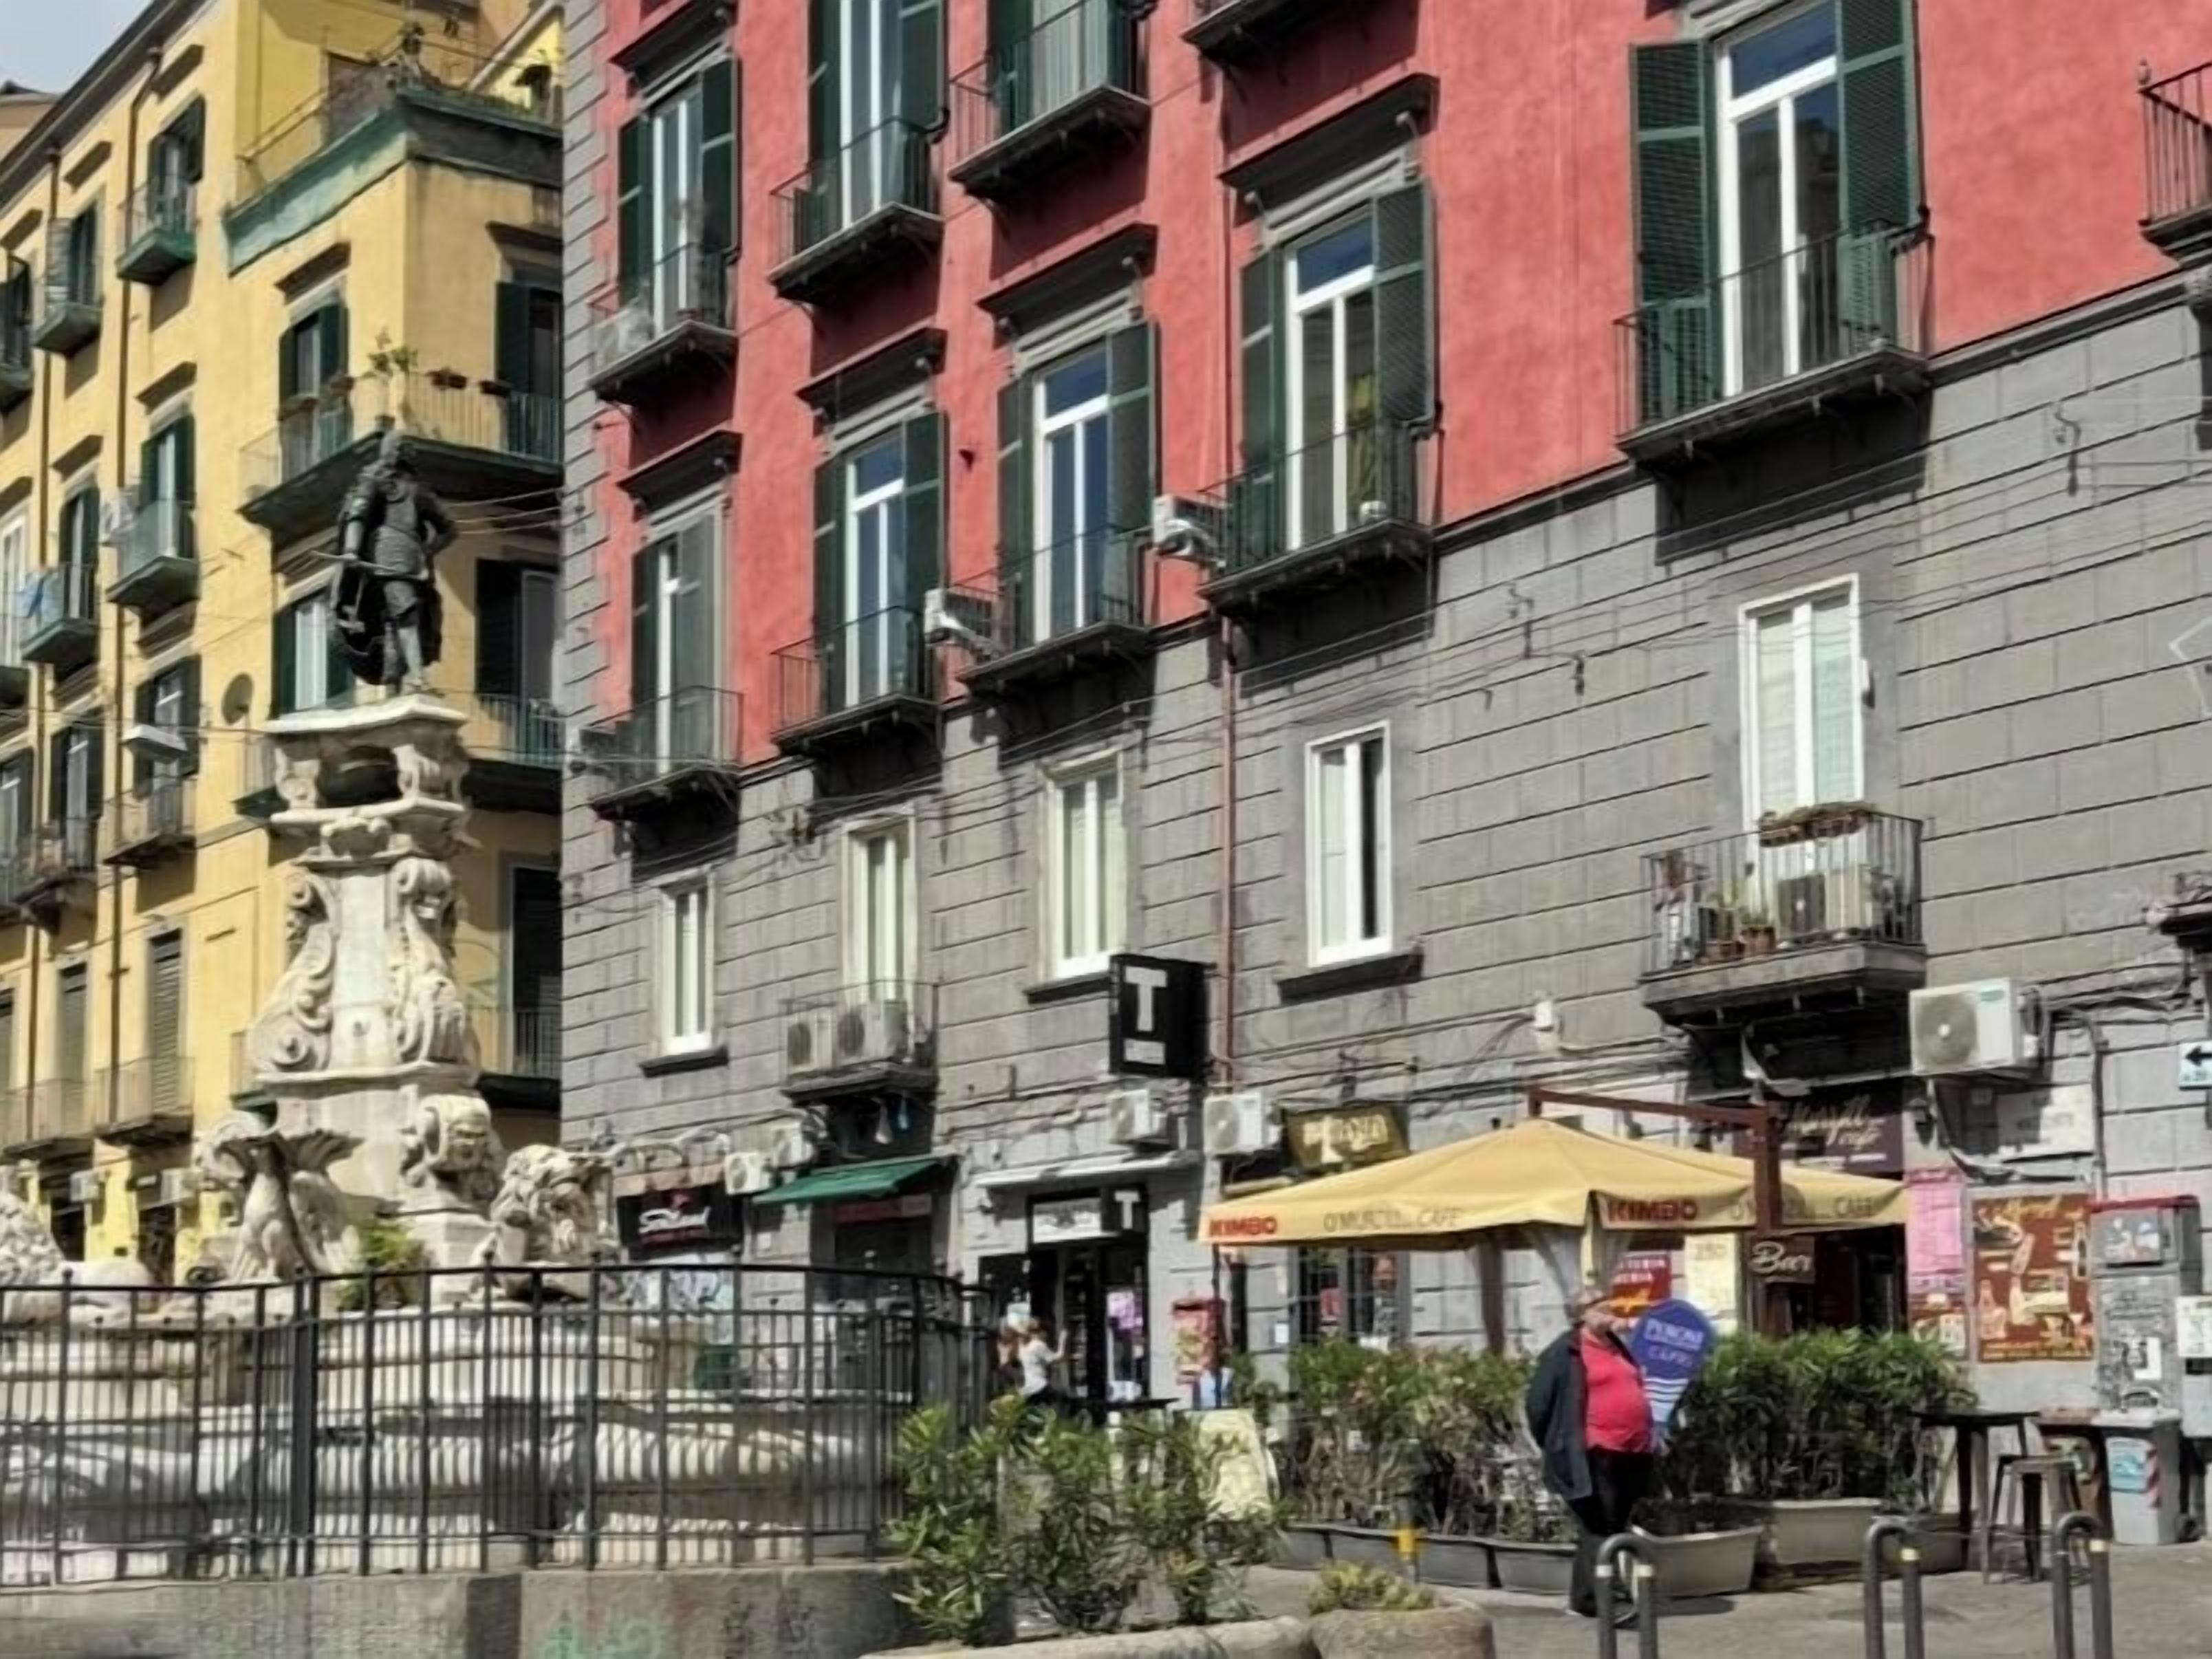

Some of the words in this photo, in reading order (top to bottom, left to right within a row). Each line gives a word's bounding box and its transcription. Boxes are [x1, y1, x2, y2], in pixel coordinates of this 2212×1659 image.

[1124, 965, 1167, 1032] T
[1114, 1191, 1140, 1229] T
[1208, 1215, 1278, 1237] KIMBO
[1607, 1200, 1698, 1222] KIMBO
[1748, 1240, 1813, 1274] Bar
